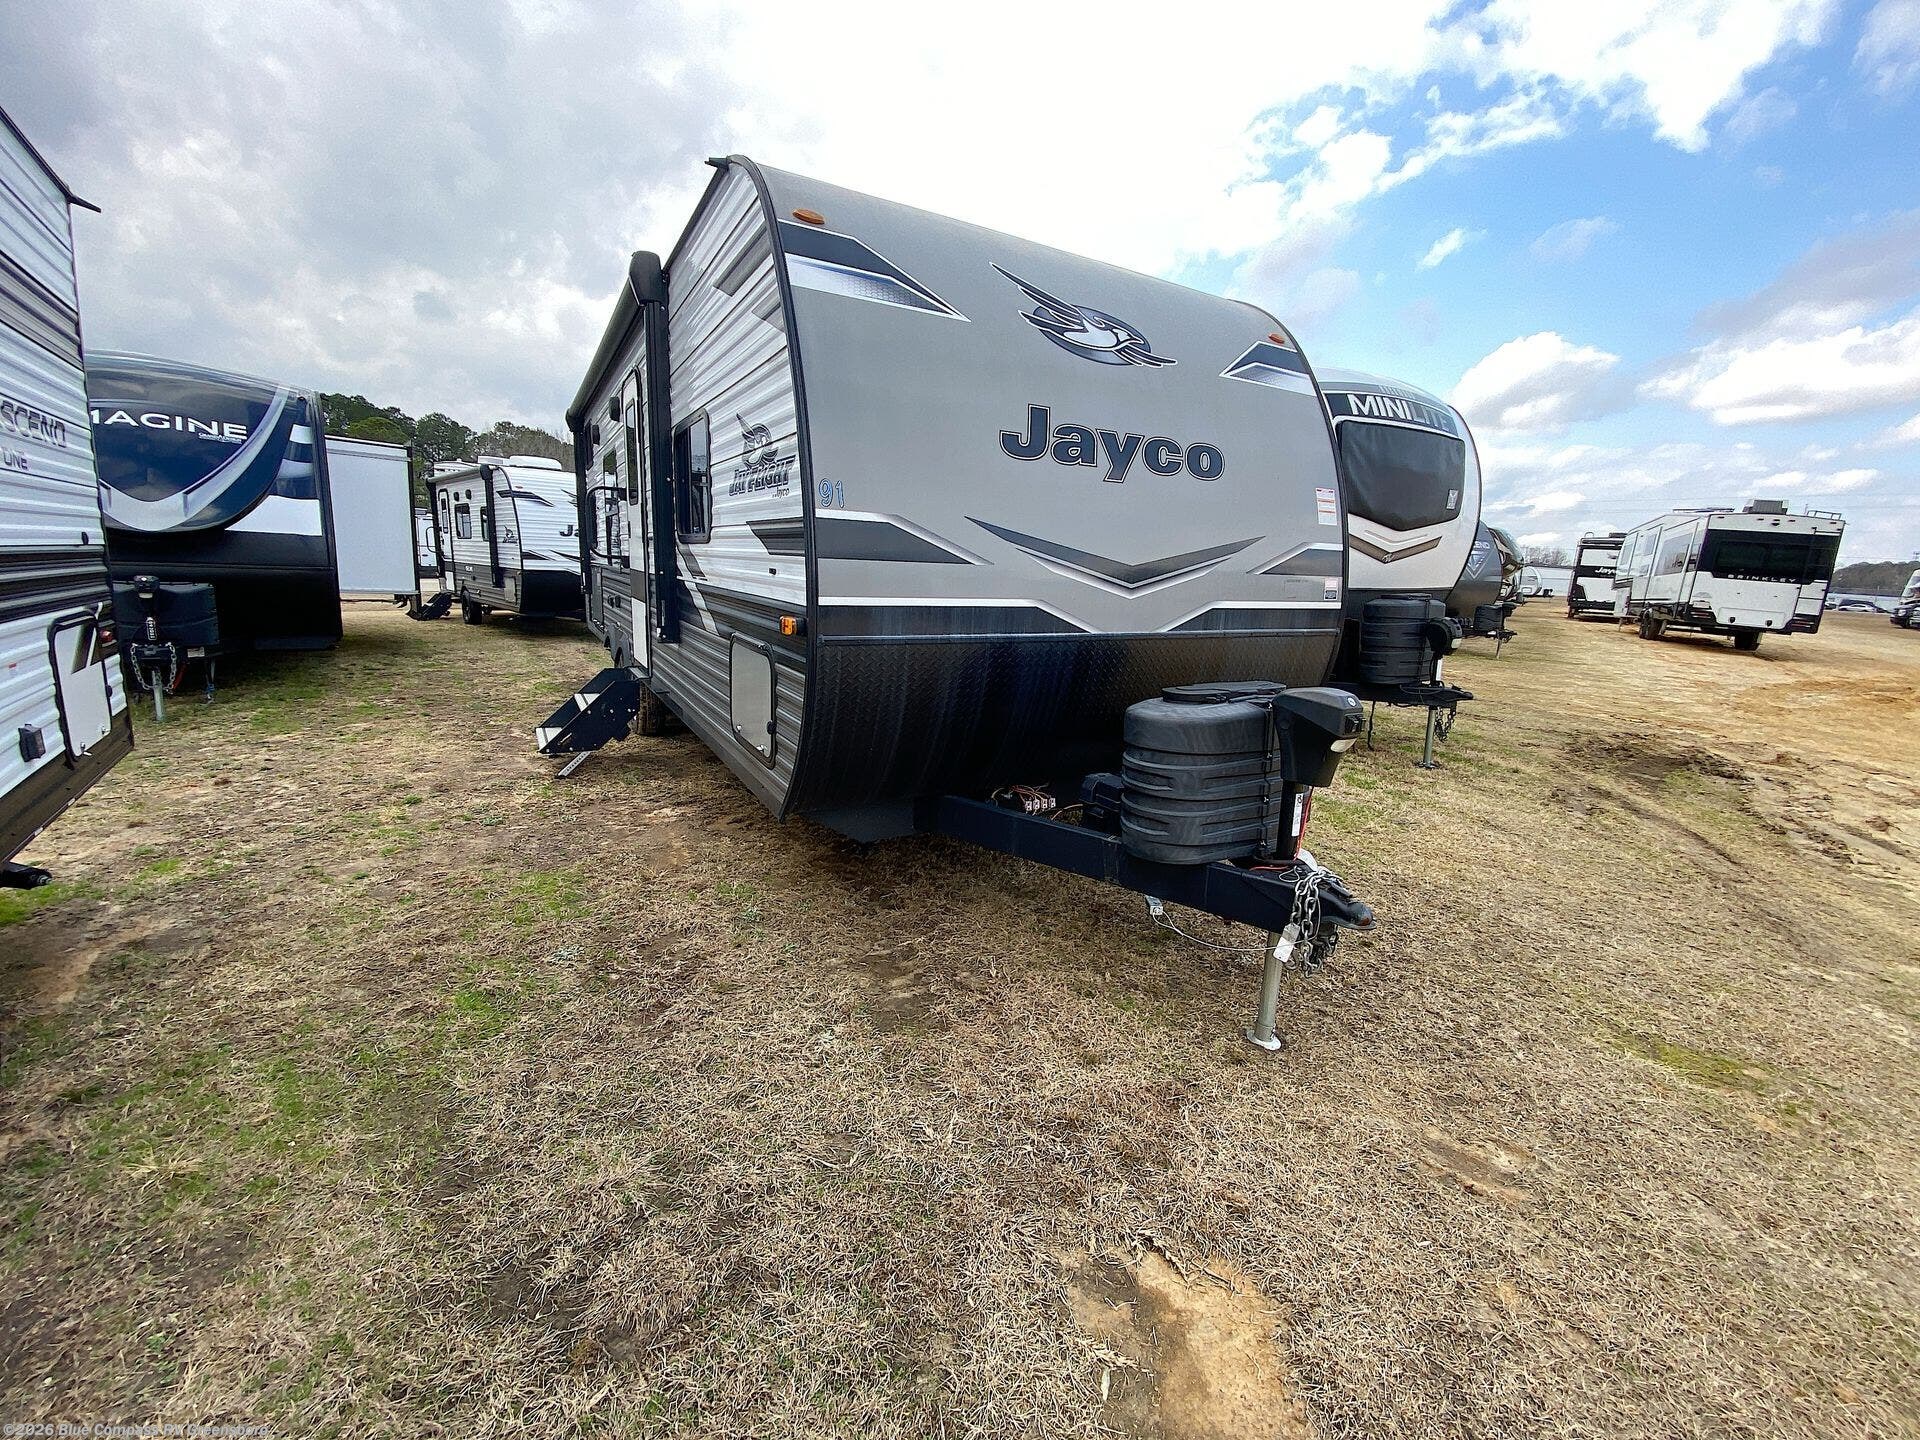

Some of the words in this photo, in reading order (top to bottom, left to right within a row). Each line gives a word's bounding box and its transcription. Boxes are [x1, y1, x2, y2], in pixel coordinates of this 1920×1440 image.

[1000, 403, 1225, 483] Jayco
[746, 455, 797, 493] FLIGHT
[819, 478, 845, 508] 91
[1728, 574, 1796, 583] BRINKLEY
